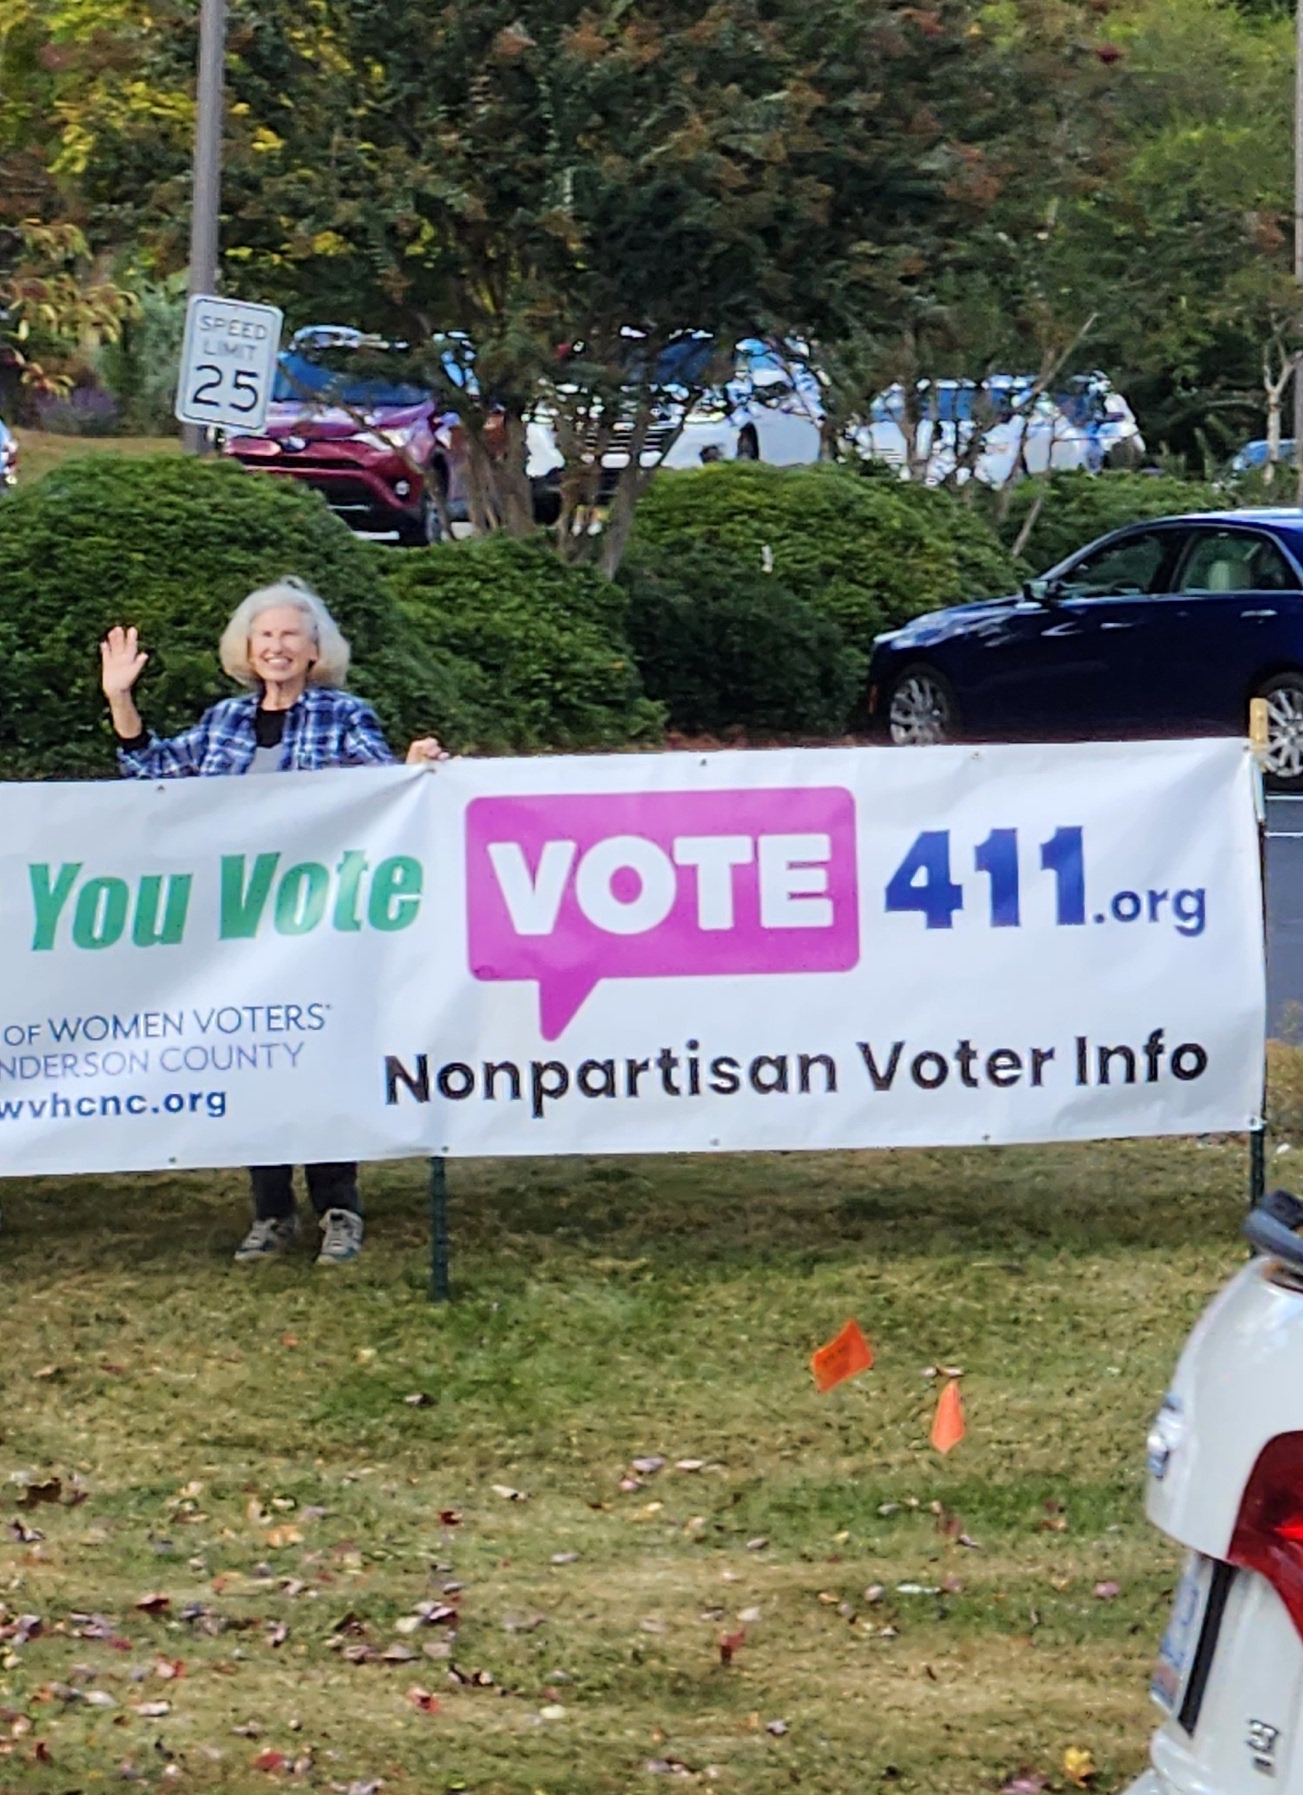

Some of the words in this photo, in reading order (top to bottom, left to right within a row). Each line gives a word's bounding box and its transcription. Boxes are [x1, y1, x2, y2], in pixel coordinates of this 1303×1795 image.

[199, 315, 267, 340] SPEED
[203, 338, 257, 359] LIMIT
[192, 365, 259, 413] 25
[28, 861, 193, 952] You
[218, 850, 424, 939] Vote
[488, 832, 834, 937] VOTE
[884, 825, 1207, 937] 411.org
[3, 1026, 40, 1046] OF
[47, 1012, 184, 1044] WOMEN
[192, 1003, 326, 1032] VOTERS
[159, 1042, 304, 1075] COUNTY
[384, 1039, 837, 1118] Nonpartisan
[856, 1037, 1055, 1093] Voter
[1075, 1028, 1209, 1087] Info
